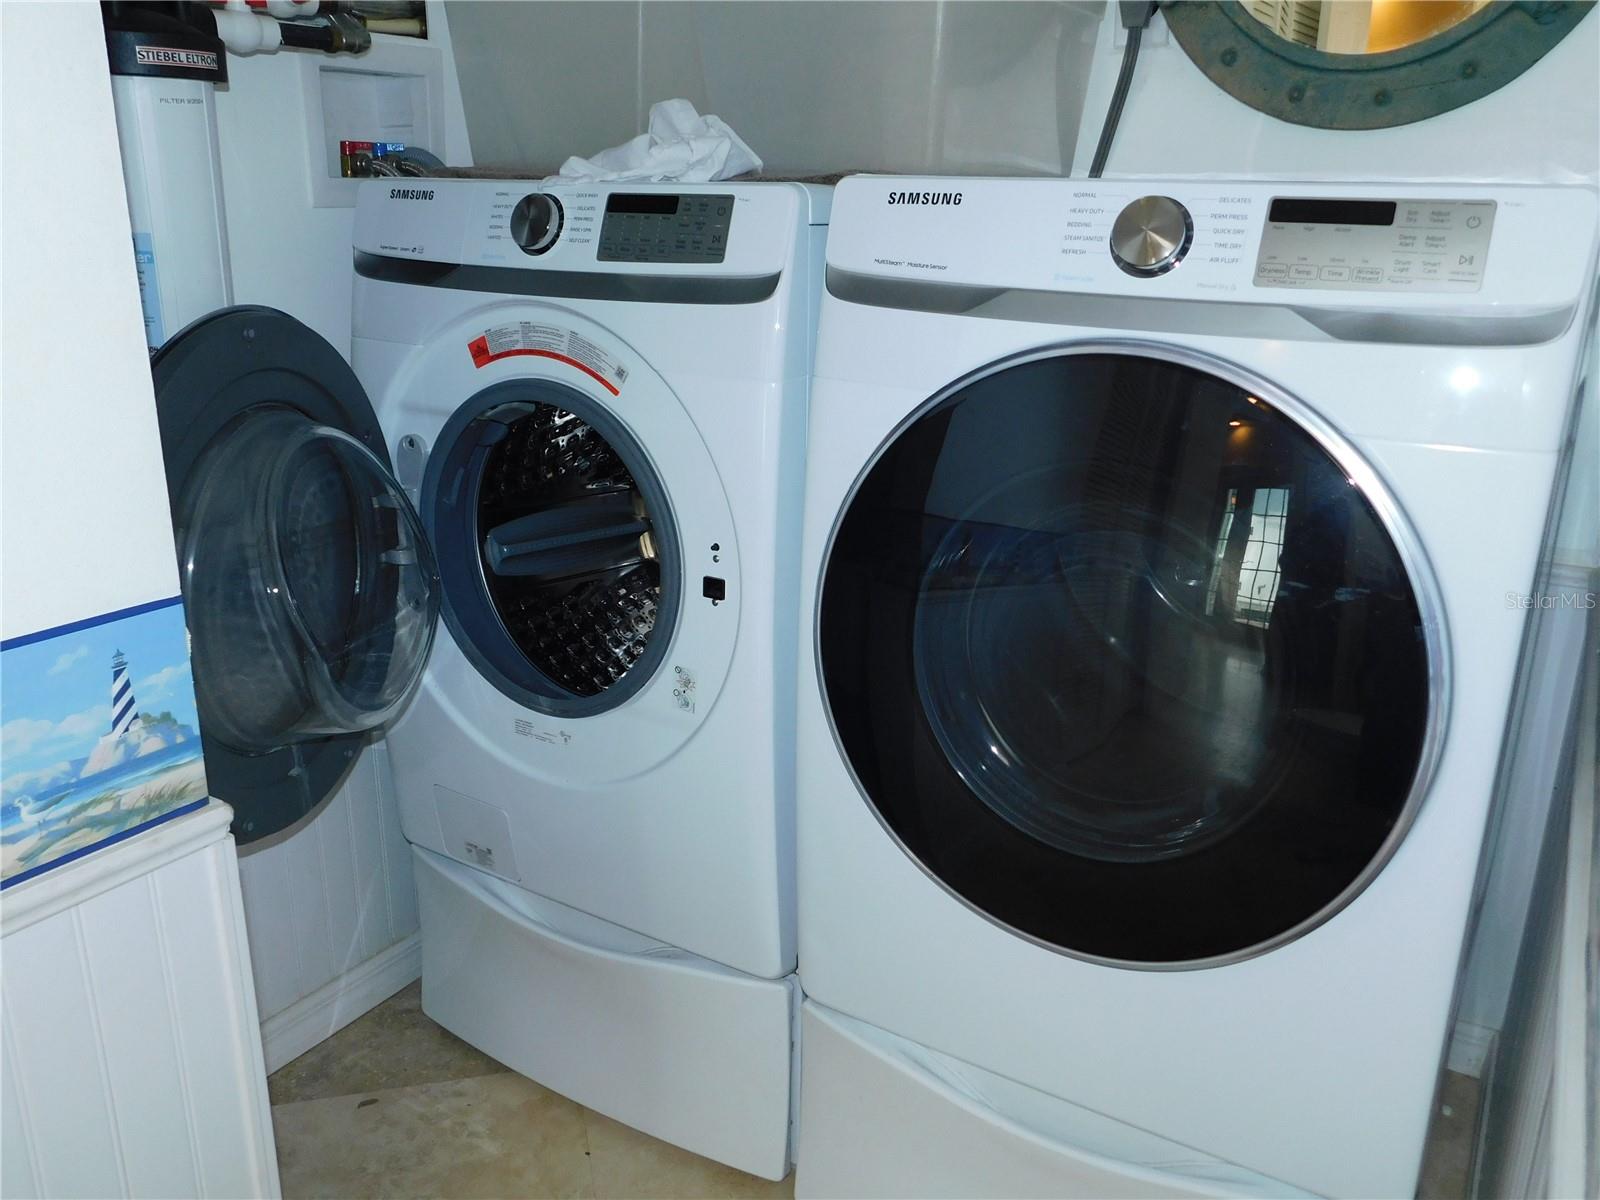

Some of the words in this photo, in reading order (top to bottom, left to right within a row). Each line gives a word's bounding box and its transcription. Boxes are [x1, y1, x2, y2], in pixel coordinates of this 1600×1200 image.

[137, 50, 185, 64] STIEBEL
[186, 54, 217, 67] ELTRON
[390, 188, 435, 201] SAMSUNG
[887, 191, 963, 206] SAMSUNG
[1069, 207, 1087, 215] HEAVY
[1210, 212, 1228, 220] PERM
[930, 263, 948, 271] Sensor
